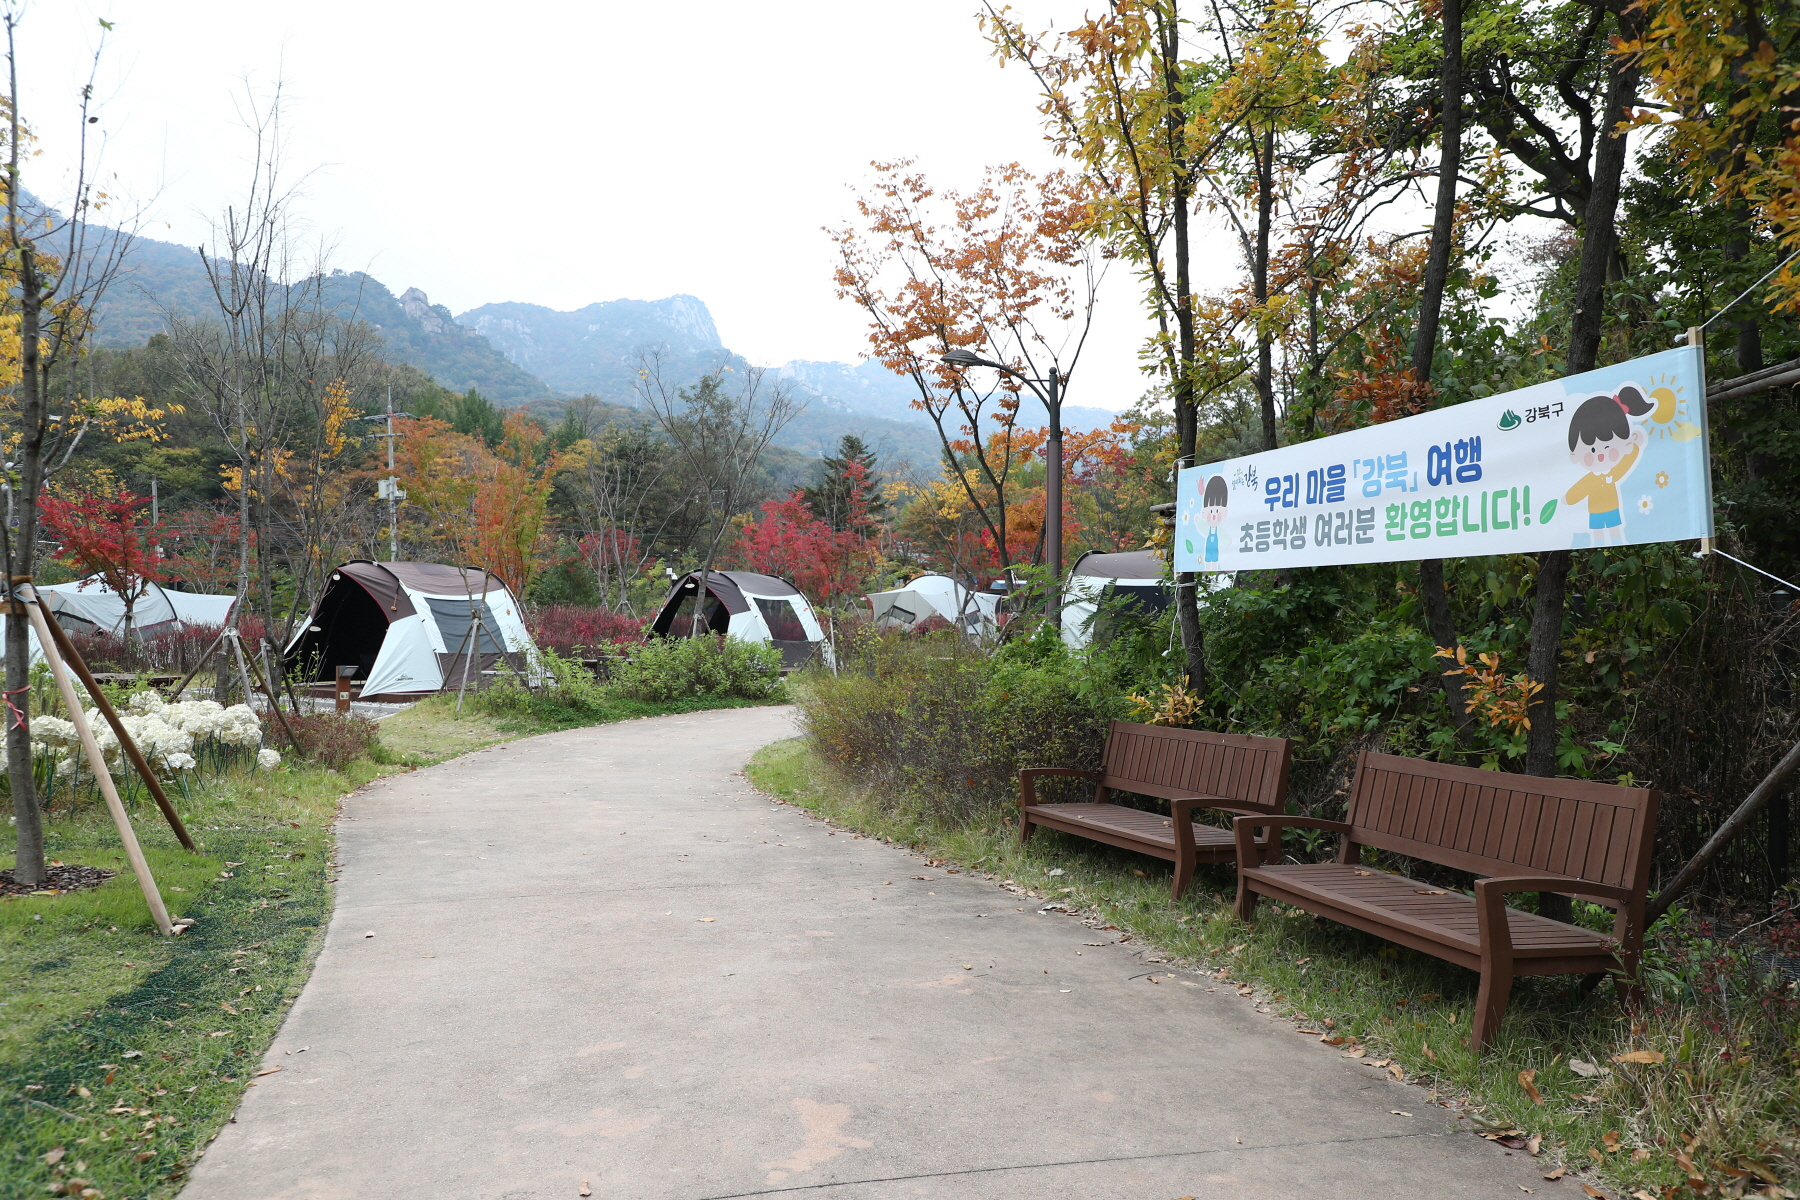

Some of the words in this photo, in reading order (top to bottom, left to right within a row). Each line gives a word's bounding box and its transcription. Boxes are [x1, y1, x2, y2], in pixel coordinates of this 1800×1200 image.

[1524, 402, 1565, 424] 강북구
[1264, 472, 1300, 511] 우리
[1306, 463, 1346, 504] 마을
[1427, 435, 1483, 487] 여행
[1239, 515, 1307, 553] 초등학생
[1314, 506, 1375, 547] 여러분
[1384, 485, 1531, 542] 환영합니다!
